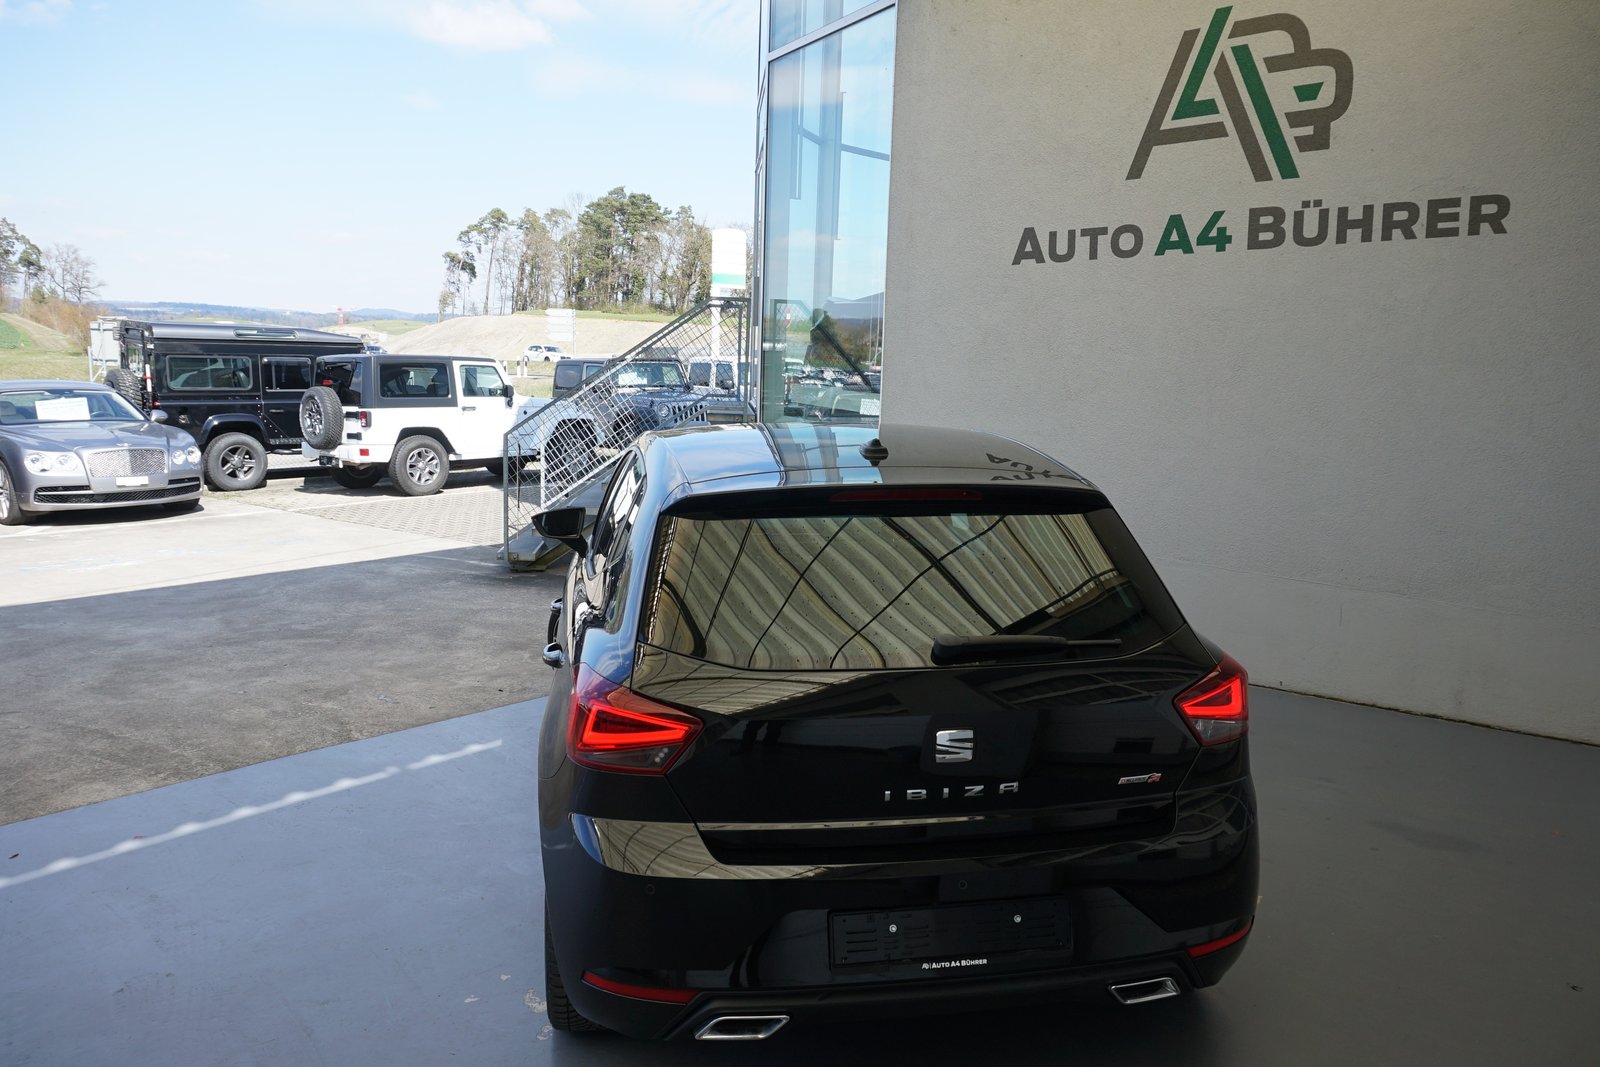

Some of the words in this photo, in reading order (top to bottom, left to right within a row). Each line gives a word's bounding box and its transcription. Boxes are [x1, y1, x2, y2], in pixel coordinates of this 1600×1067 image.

[1011, 223, 1144, 266] AUTO
[1154, 210, 1232, 257] A4
[1246, 193, 1511, 251] BÜHRER
[884, 781, 1019, 801] IBIZA
